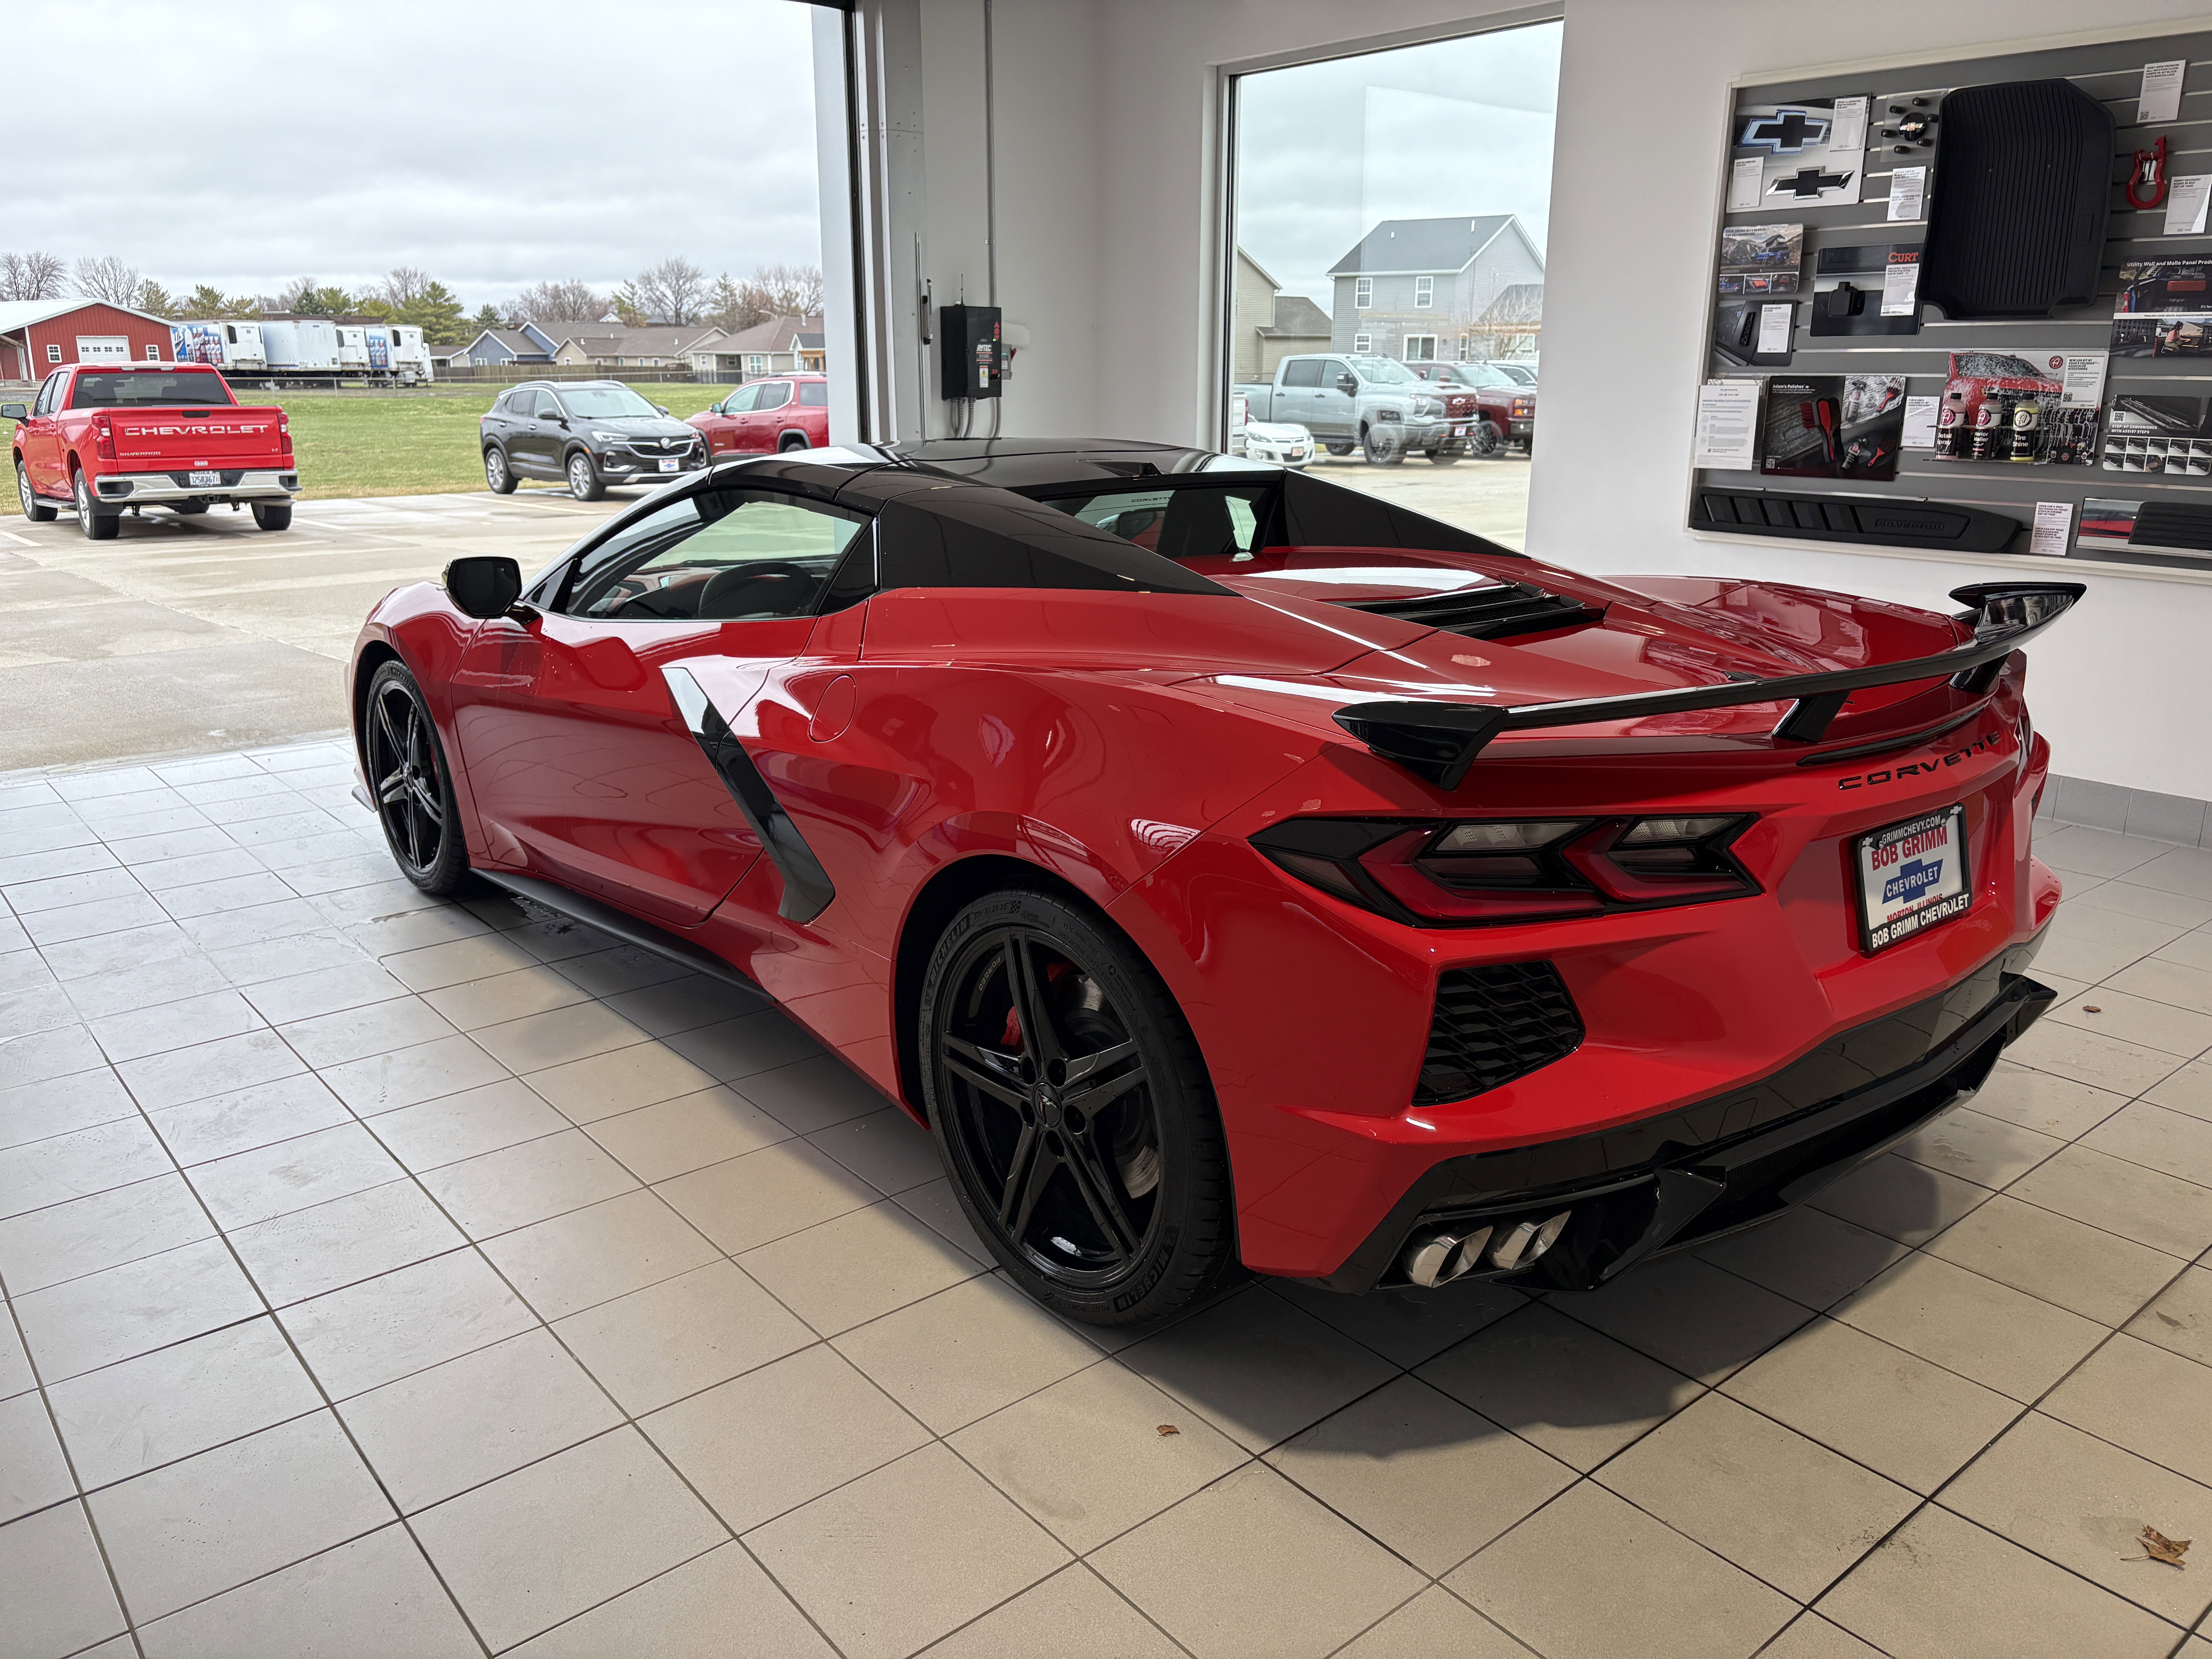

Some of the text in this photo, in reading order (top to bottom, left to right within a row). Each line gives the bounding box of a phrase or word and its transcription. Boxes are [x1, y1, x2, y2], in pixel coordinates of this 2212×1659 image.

[1888, 252, 1918, 263] CURT
[125, 425, 268, 435] CHEVROLET
[1838, 731, 2001, 790] CORVETTE
[1882, 814, 1941, 845] GRIMMCHEVY.COM
[1871, 825, 1948, 871] BOB GRIMM
[1886, 866, 1938, 897] CHEVROLET
[1872, 893, 1970, 948] BOB GRIMM CHEVROLET
[1886, 893, 1943, 923] MORTON ILLINOIS
[930, 916, 968, 985] MICHELIN
[978, 957, 1001, 991] FORGED
[1116, 1248, 1170, 1311] MICHELIN
